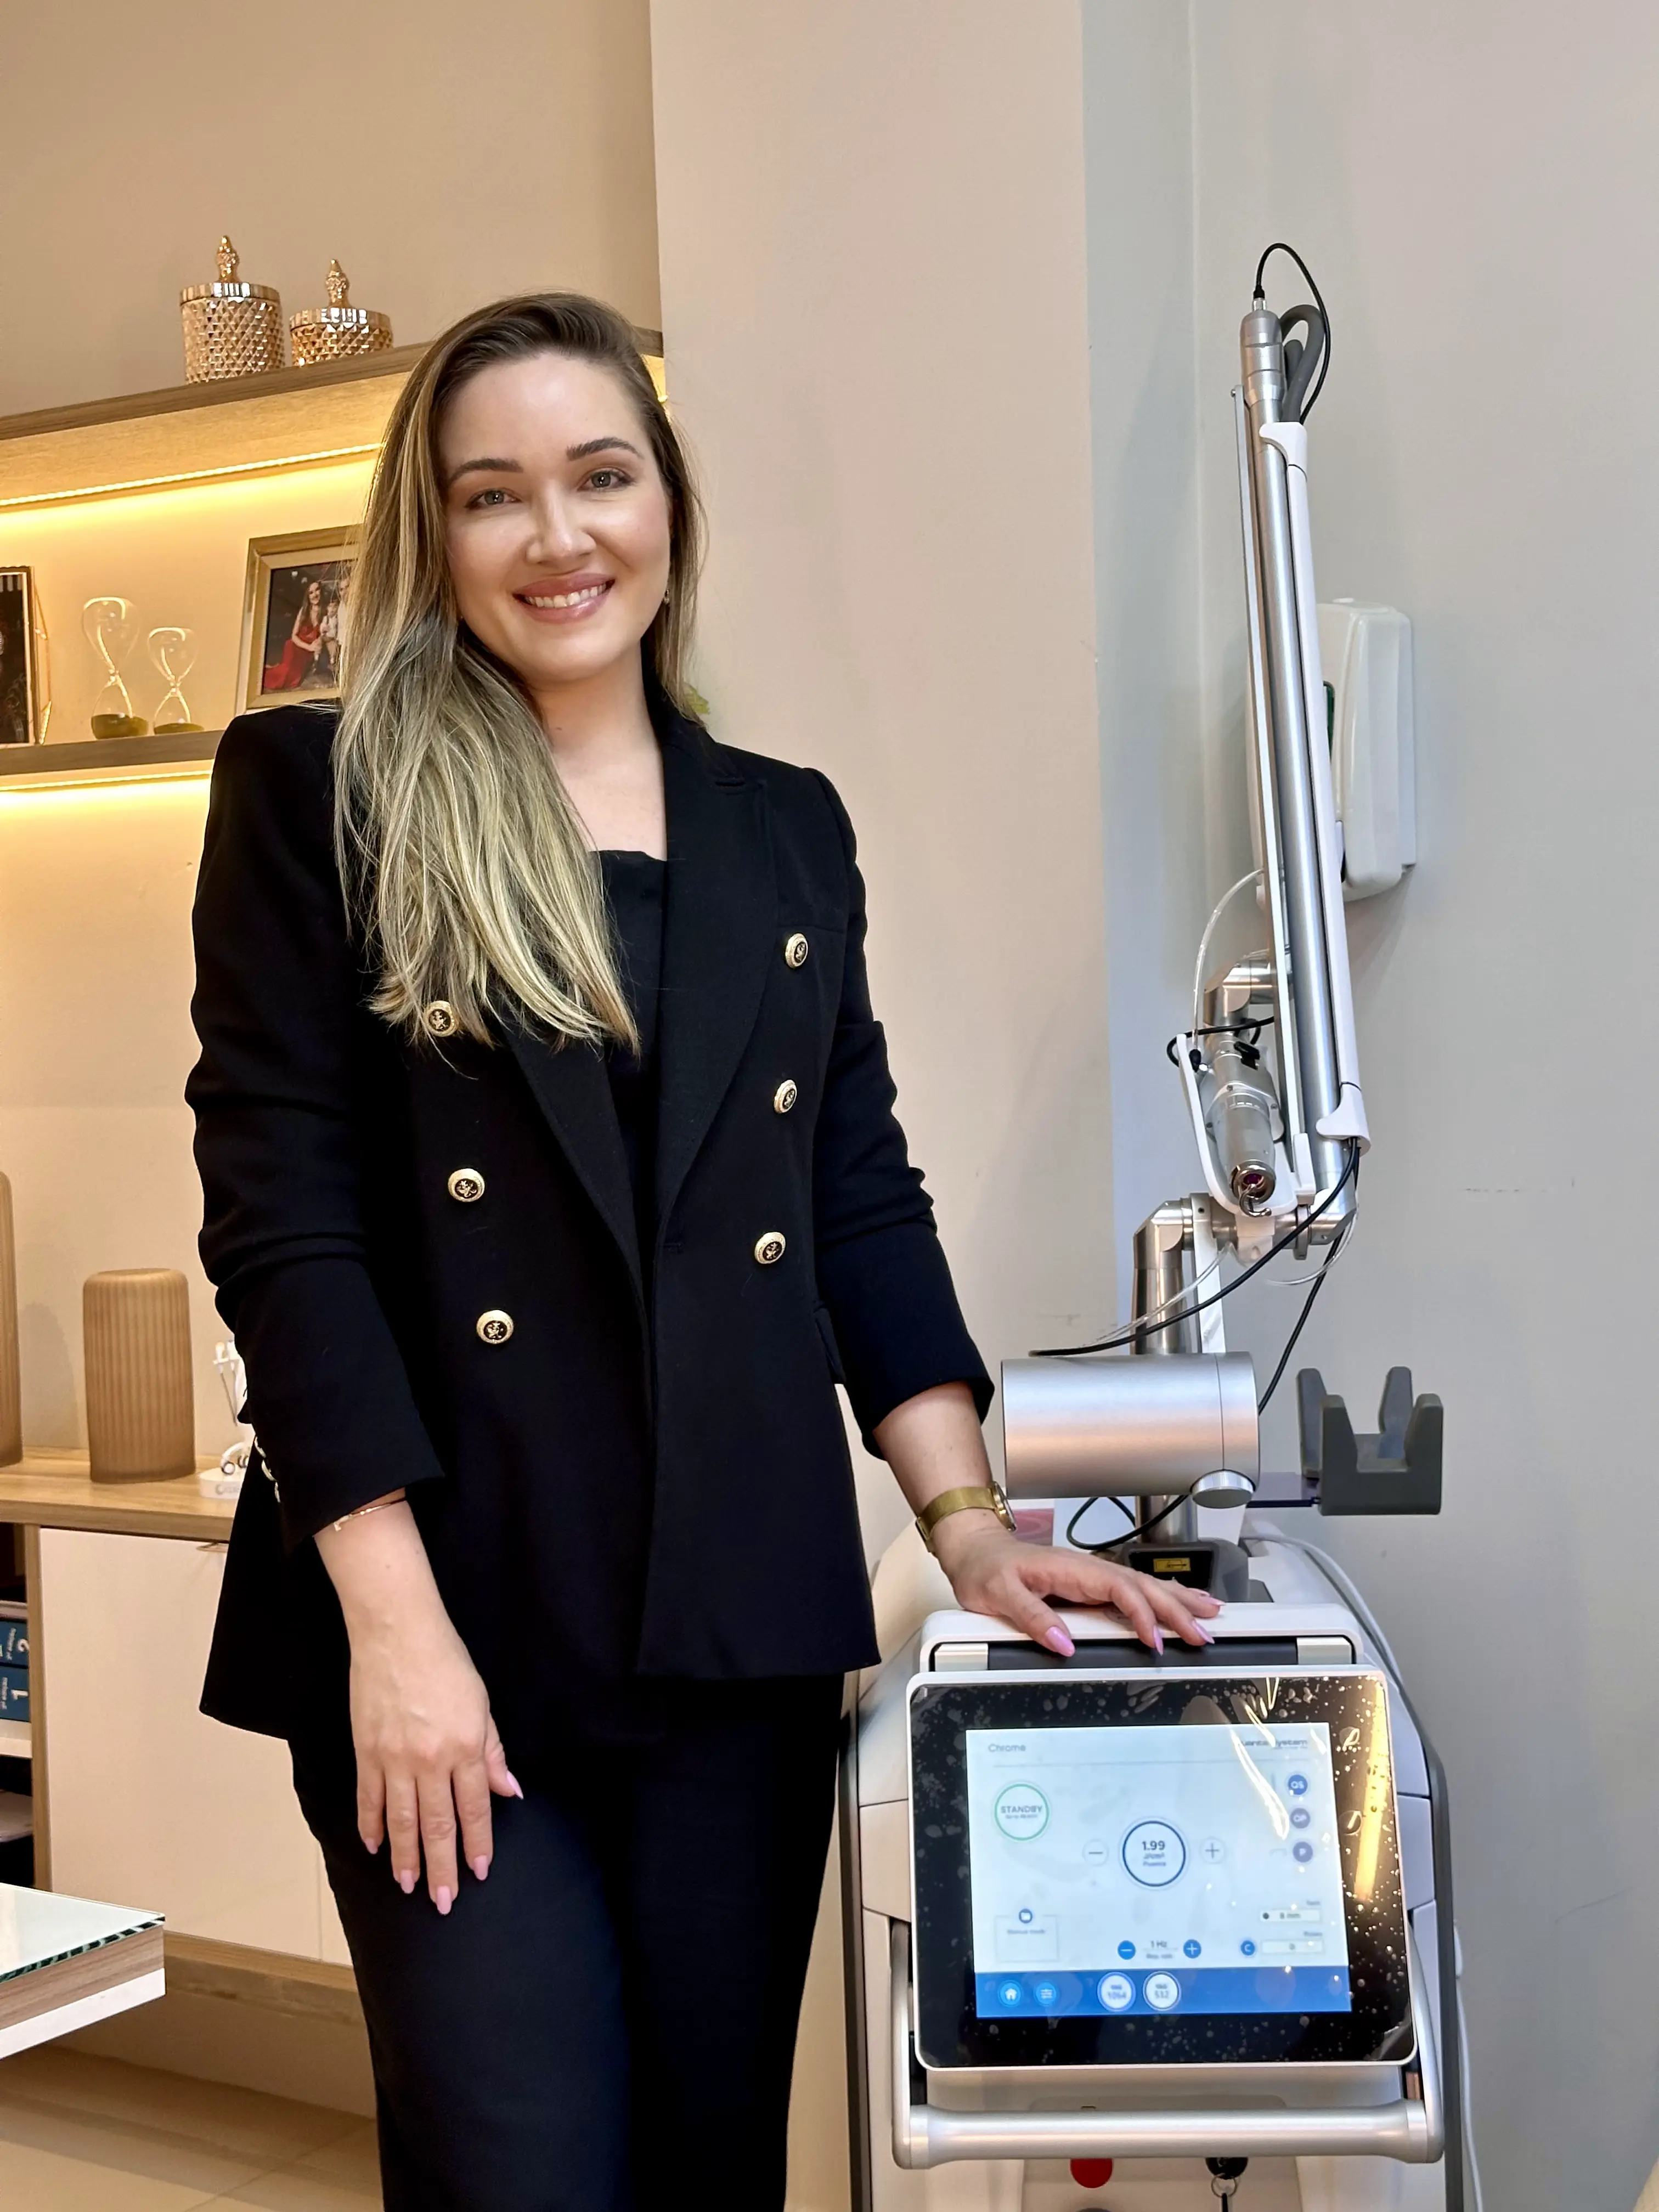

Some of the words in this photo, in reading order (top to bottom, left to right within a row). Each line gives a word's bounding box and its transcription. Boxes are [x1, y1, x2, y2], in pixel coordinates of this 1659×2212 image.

[988, 1743, 1026, 1752] Chrome
[1001, 1805, 1042, 1814] STANDBY
[1142, 1840, 1165, 1850] 1.99
